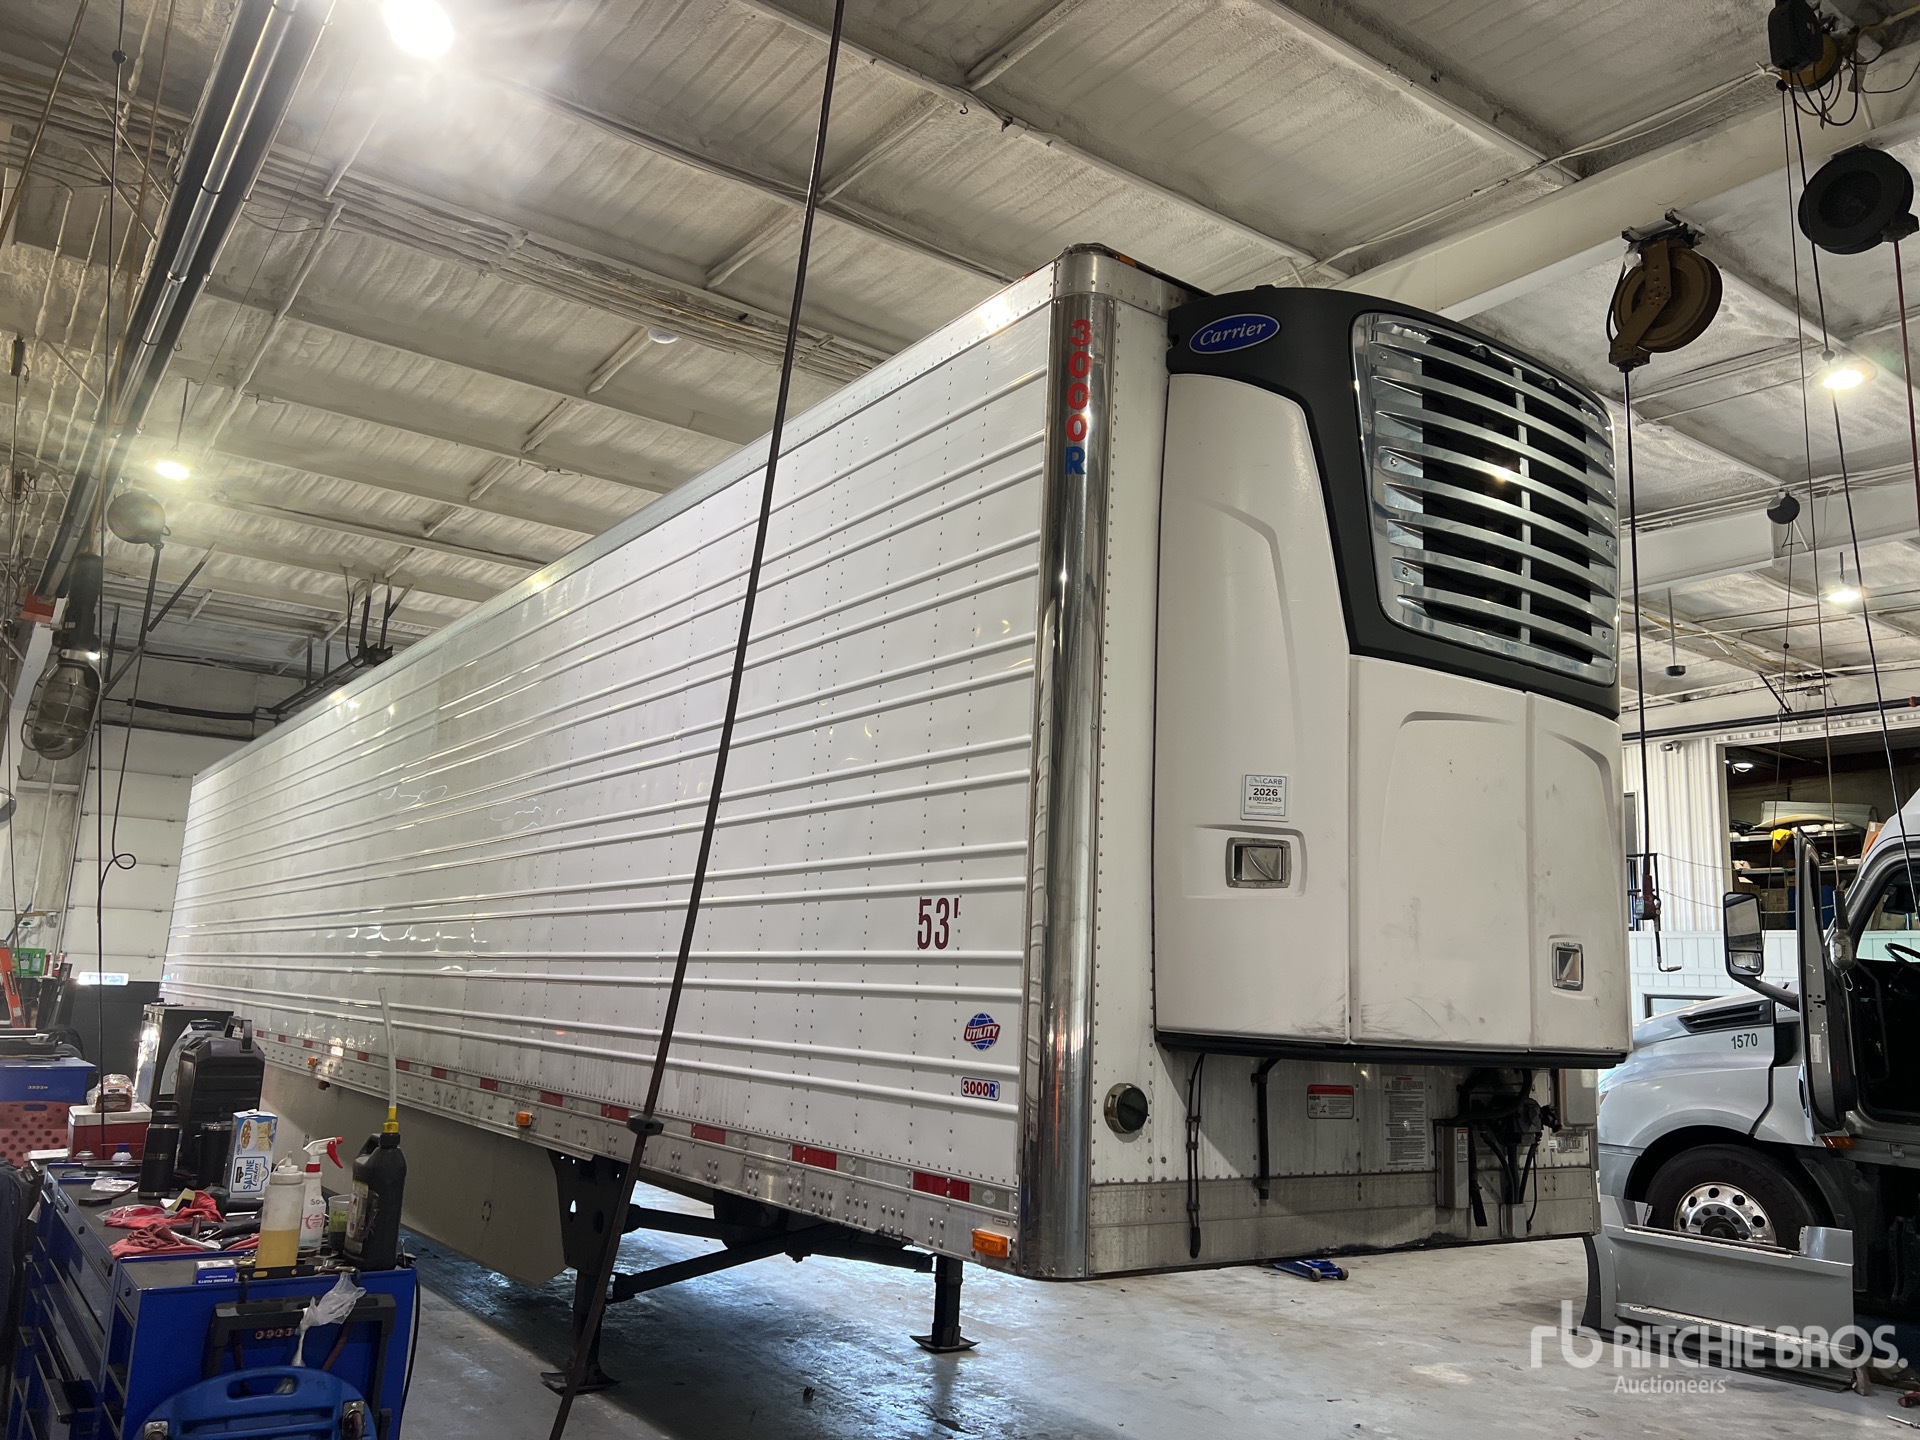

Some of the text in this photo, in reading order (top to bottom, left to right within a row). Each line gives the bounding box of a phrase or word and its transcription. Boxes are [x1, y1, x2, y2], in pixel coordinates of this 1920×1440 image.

[1199, 322, 1267, 346] Carrier
[1254, 788, 1278, 796] 2026
[917, 897, 960, 950] 53'
[965, 1025, 999, 1041] UTILITY
[1731, 1033, 1758, 1050] 1570
[963, 1080, 997, 1098] 3000R
[243, 1159, 255, 1190] SALTINE
